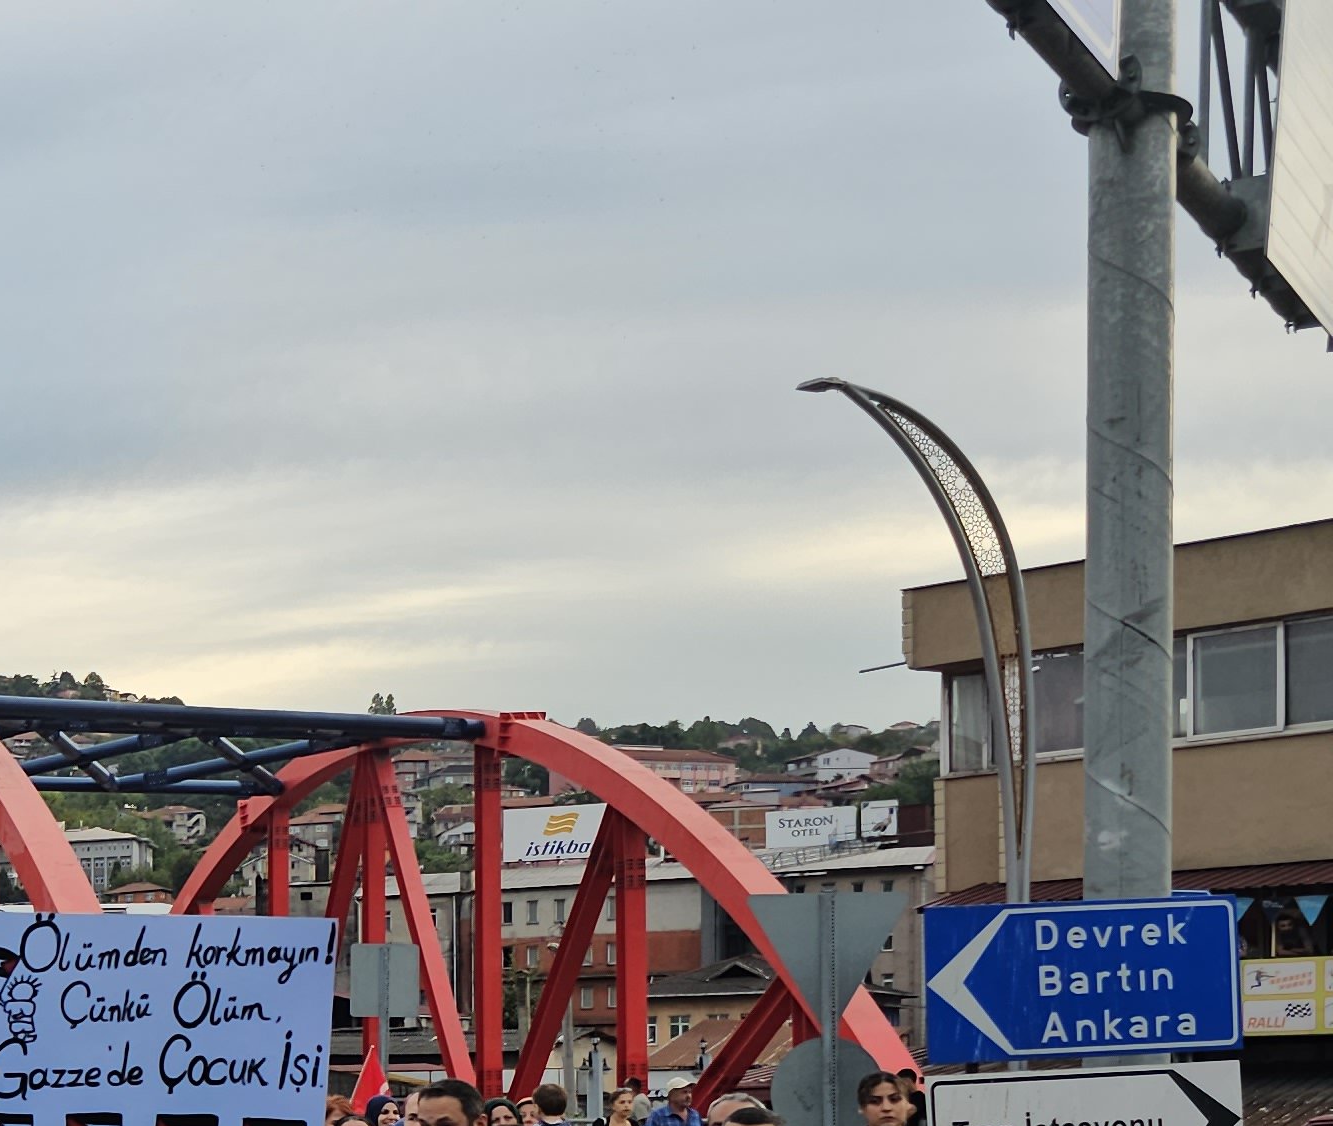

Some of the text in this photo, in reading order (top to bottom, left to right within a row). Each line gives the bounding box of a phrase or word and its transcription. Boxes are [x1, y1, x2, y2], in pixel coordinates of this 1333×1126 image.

[778, 815, 833, 829] STARON
[791, 828, 821, 838] OTEL
[526, 840, 591, 856] istikba
[20, 912, 337, 984] Ölümden korkmayın!
[1034, 913, 1188, 951] Devrek
[1038, 963, 1174, 997] Bartın
[60, 971, 282, 1029] Çünkü Ölüm,
[1041, 1008, 1197, 1044] Ankara
